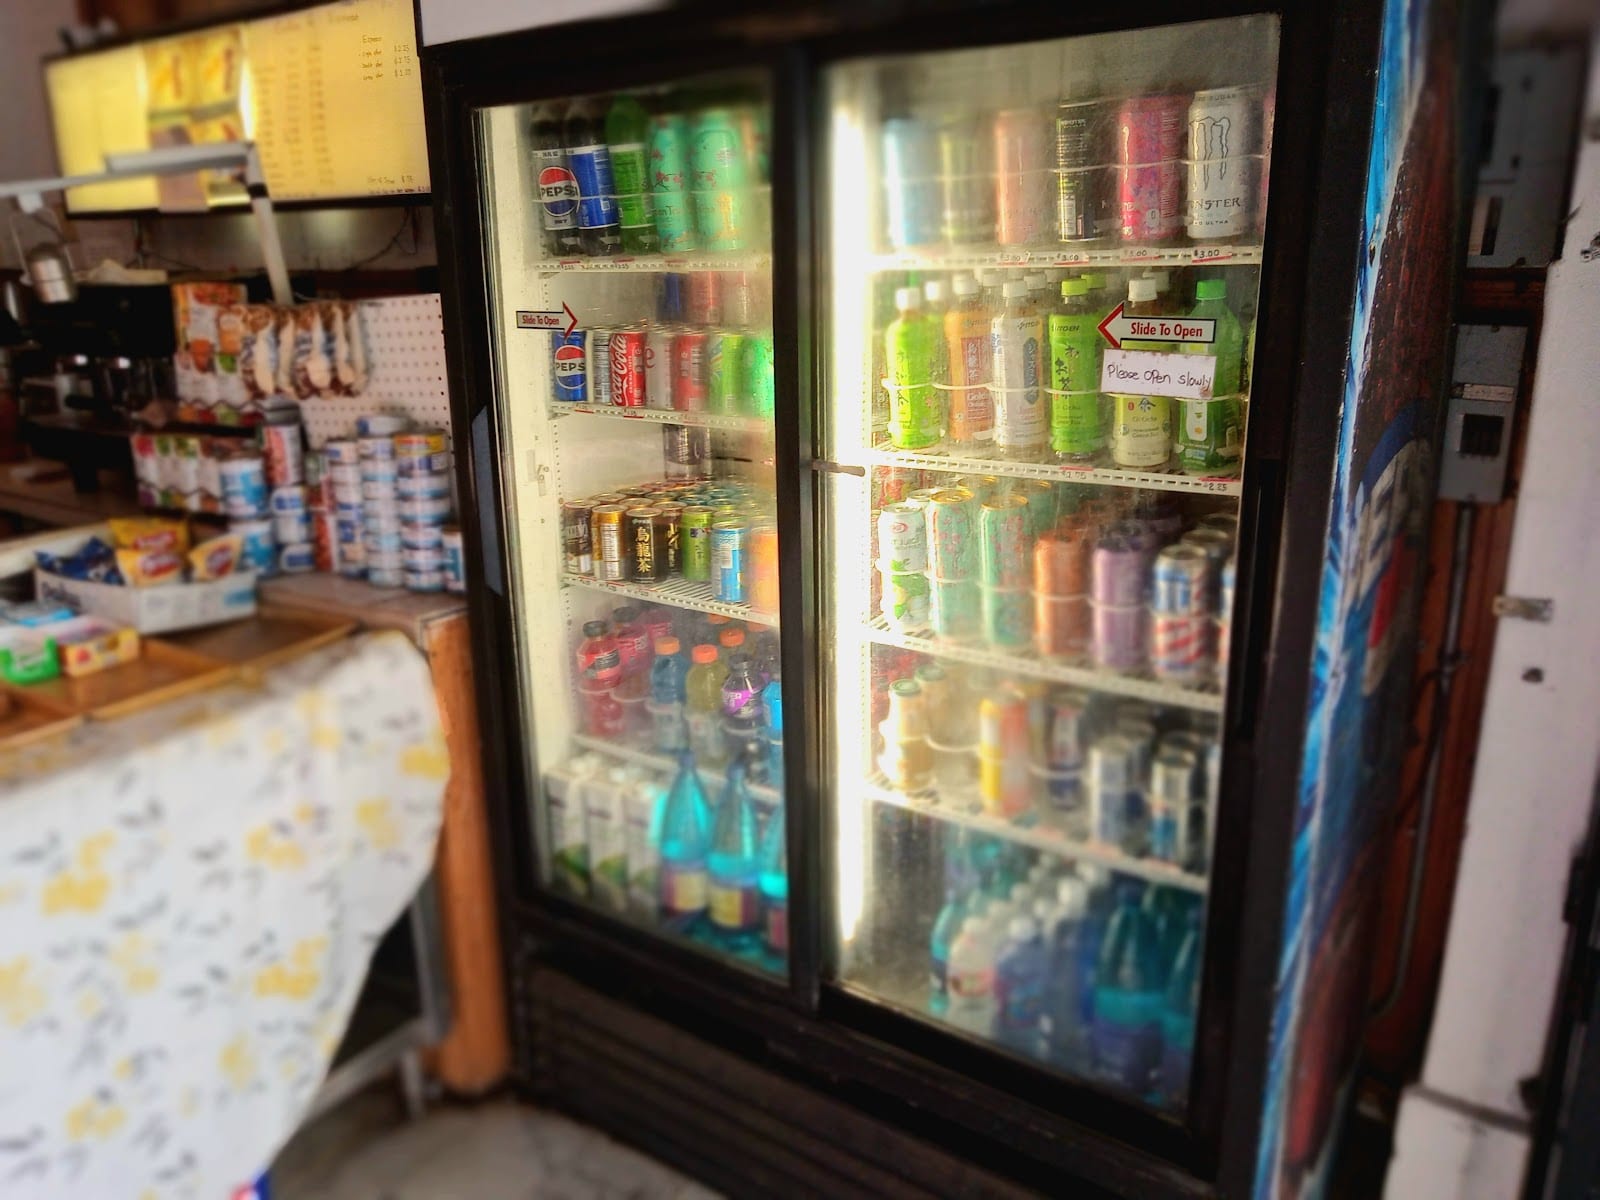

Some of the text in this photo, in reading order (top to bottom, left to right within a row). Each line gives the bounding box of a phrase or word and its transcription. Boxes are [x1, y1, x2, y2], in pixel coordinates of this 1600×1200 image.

[1194, 249, 1220, 259] $3.00
[522, 315, 560, 327] Slide To Open
[1130, 322, 1204, 340] Slide To Open
[555, 362, 586, 372] PEPS
[1107, 364, 1140, 382] Please
[1177, 371, 1213, 391] slowly
